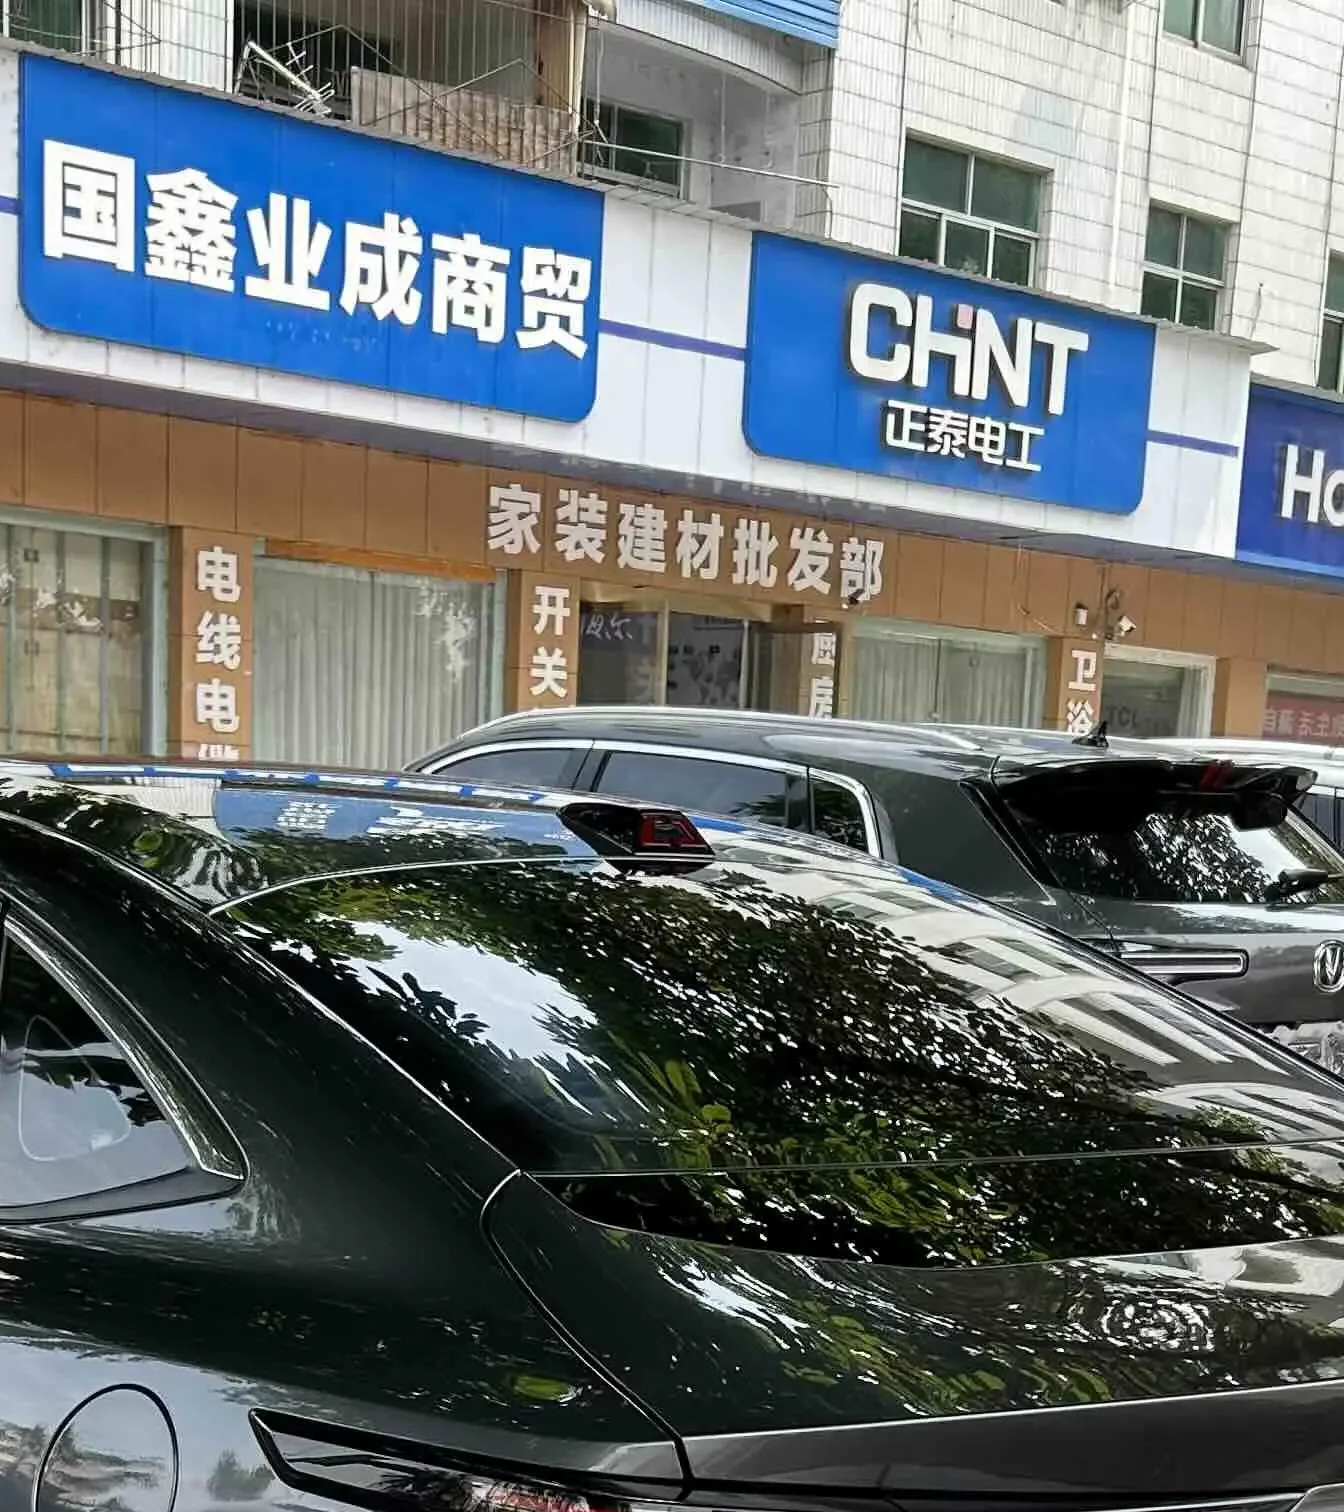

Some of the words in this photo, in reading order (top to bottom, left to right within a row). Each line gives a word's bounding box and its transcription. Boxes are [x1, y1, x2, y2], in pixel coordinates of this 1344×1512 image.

[42, 139, 594, 360] 国鑫业成商贸
[850, 282, 1089, 415] CHNT
[884, 399, 1045, 473] 正泰电工
[486, 483, 887, 602] 家装建材批发部
